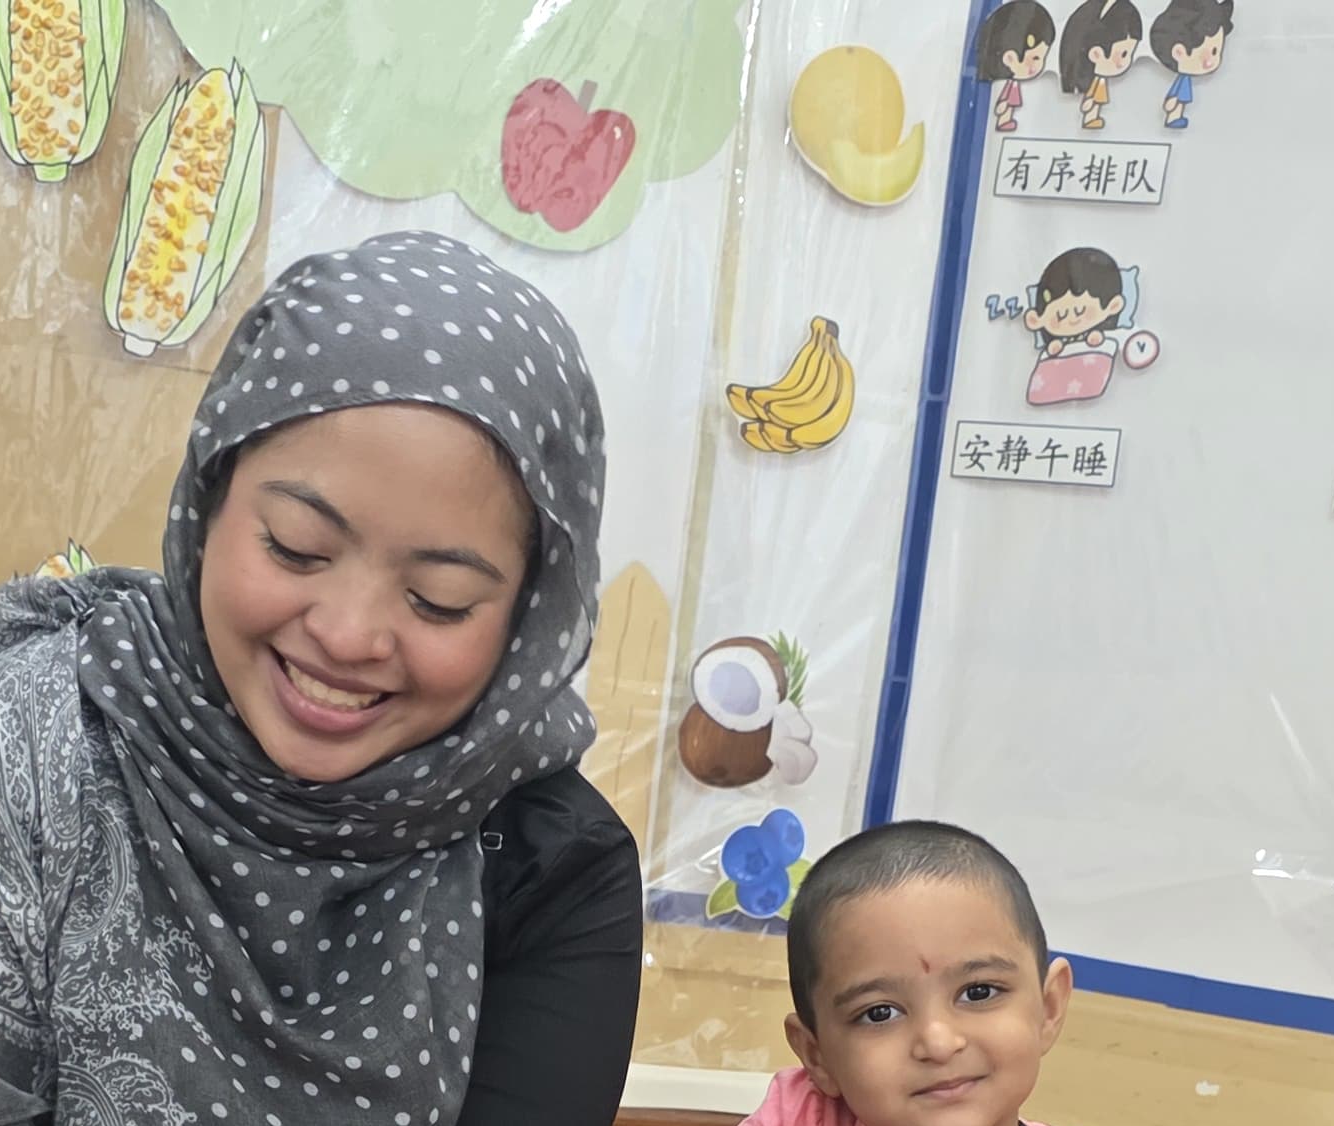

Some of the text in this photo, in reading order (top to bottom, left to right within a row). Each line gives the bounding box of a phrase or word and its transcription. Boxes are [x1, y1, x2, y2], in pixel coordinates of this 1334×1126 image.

[1003, 149, 1157, 196] 有序排队
[959, 434, 1107, 478] 安静午睡
